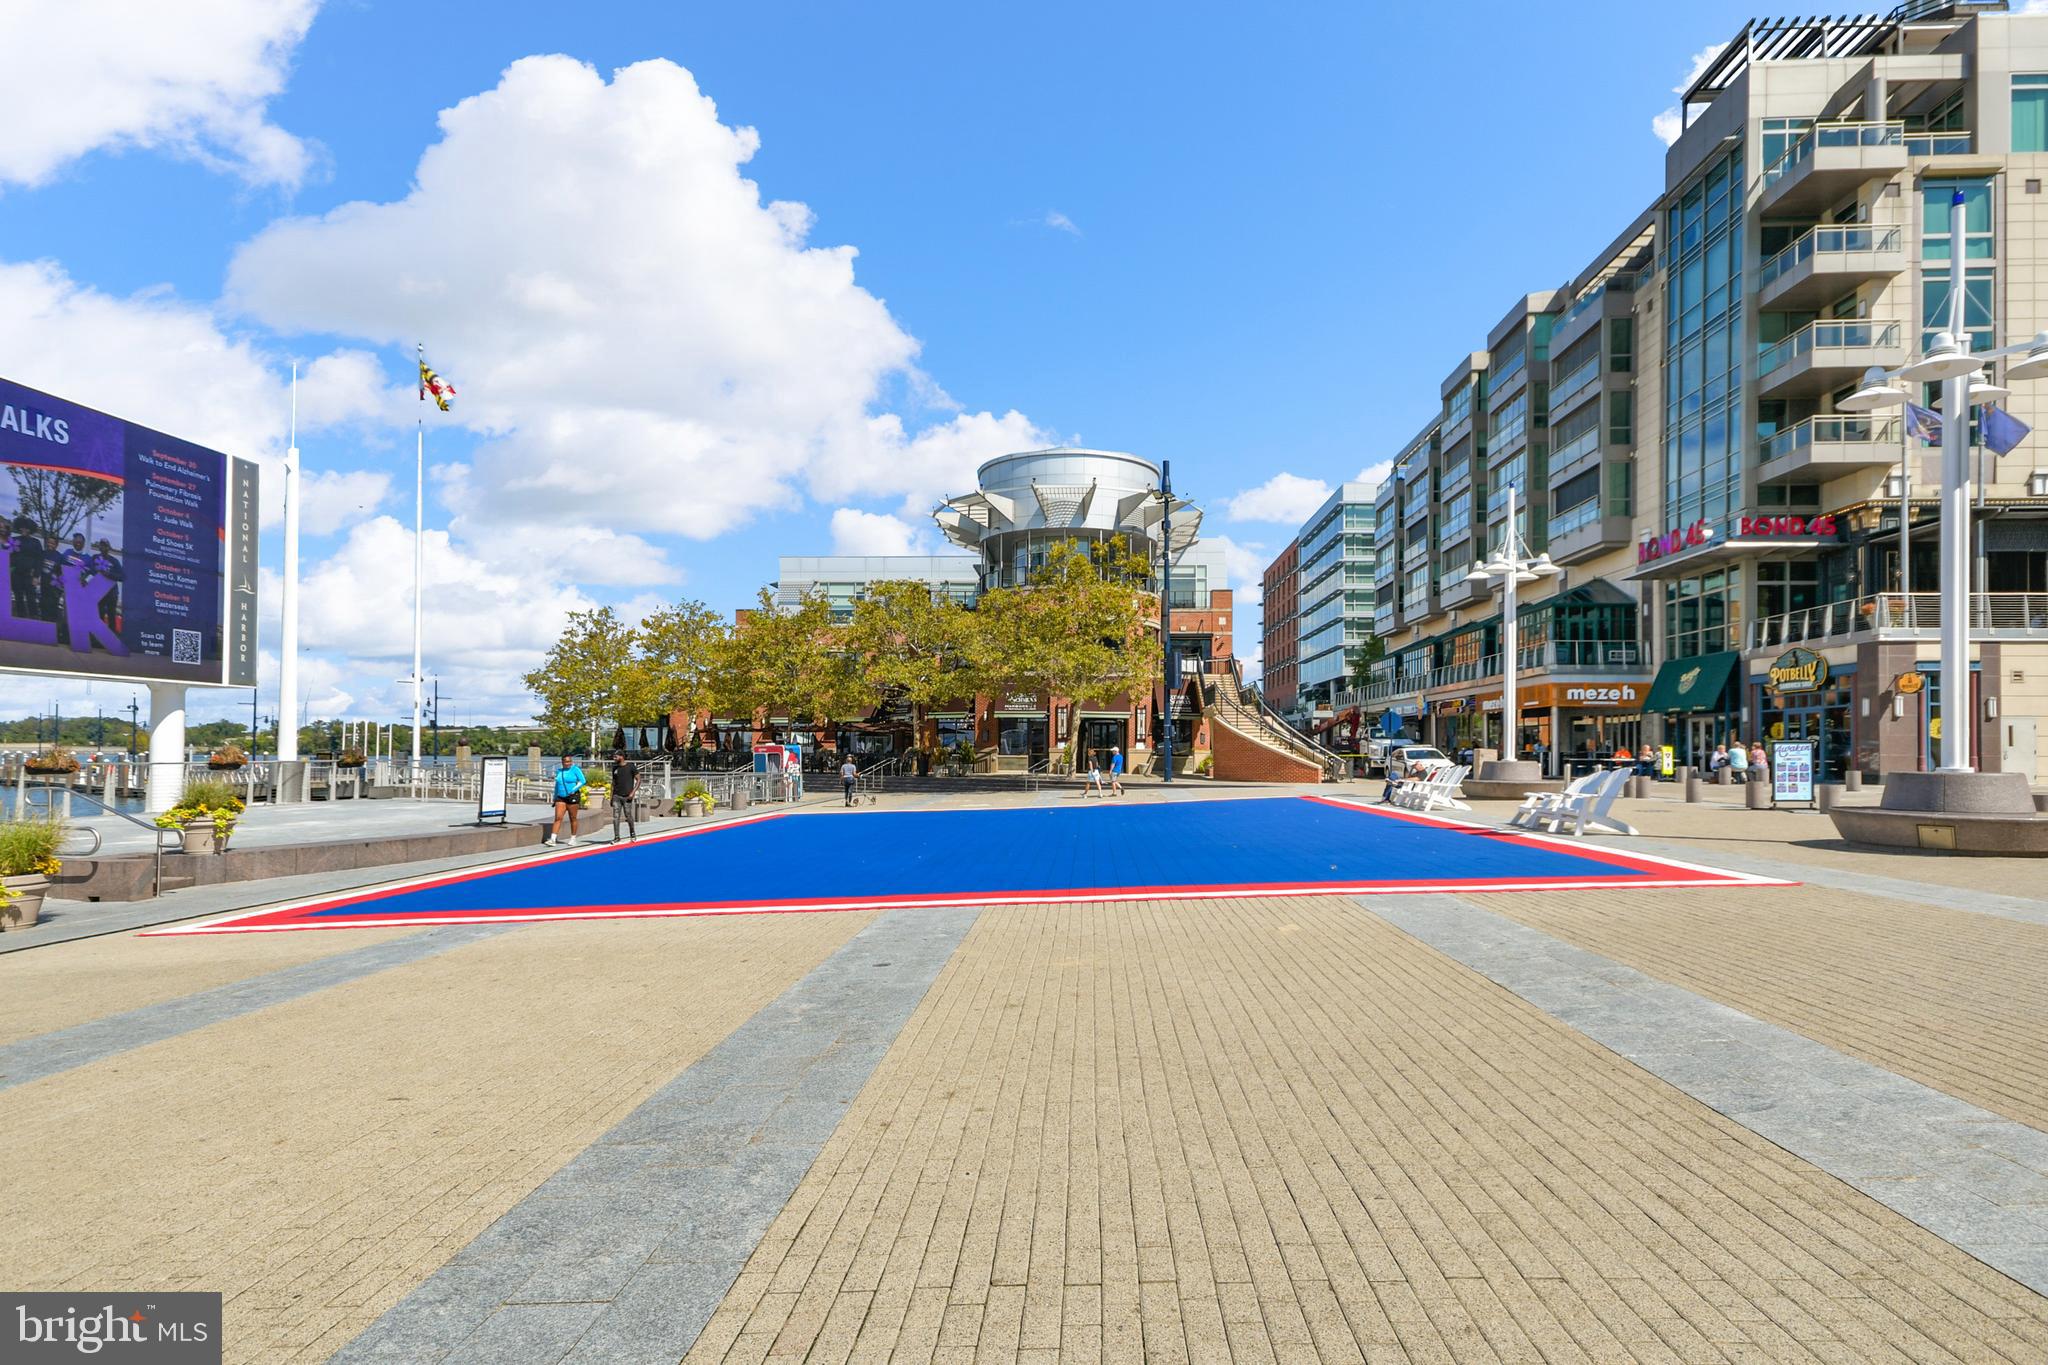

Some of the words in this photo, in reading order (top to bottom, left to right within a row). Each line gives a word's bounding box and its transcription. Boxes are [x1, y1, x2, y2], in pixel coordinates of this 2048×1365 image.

[138, 454, 154, 465] Walk
[164, 462, 176, 471] End
[177, 467, 211, 482] Alzheimer's
[145, 479, 178, 495] Pulmonary
[179, 488, 202, 501] Fibrosis
[148, 488, 183, 504] Foundation
[184, 499, 199, 508] Walk
[158, 506, 184, 517] October
[163, 516, 178, 525] Jude
[179, 520, 193, 529] Walk
[1741, 516, 1806, 536] BOND
[1811, 517, 1838, 537] 45
[157, 528, 184, 540] October
[1638, 528, 1682, 566] BOND
[1685, 516, 1707, 546] 45
[152, 535, 166, 544] Red
[166, 538, 184, 549] Shoes
[154, 562, 181, 572] October
[148, 569, 168, 579] Susan
[168, 573, 175, 581] G.
[176, 575, 198, 584] Komen
[154, 591, 181, 601] October
[155, 599, 189, 611] Easterseals
[140, 631, 155, 639] Scan
[239, 602, 248, 662] HARBOR
[148, 640, 164, 648] learn
[1770, 661, 1818, 686] POTBELLY
[1567, 684, 1635, 700] mezeh
